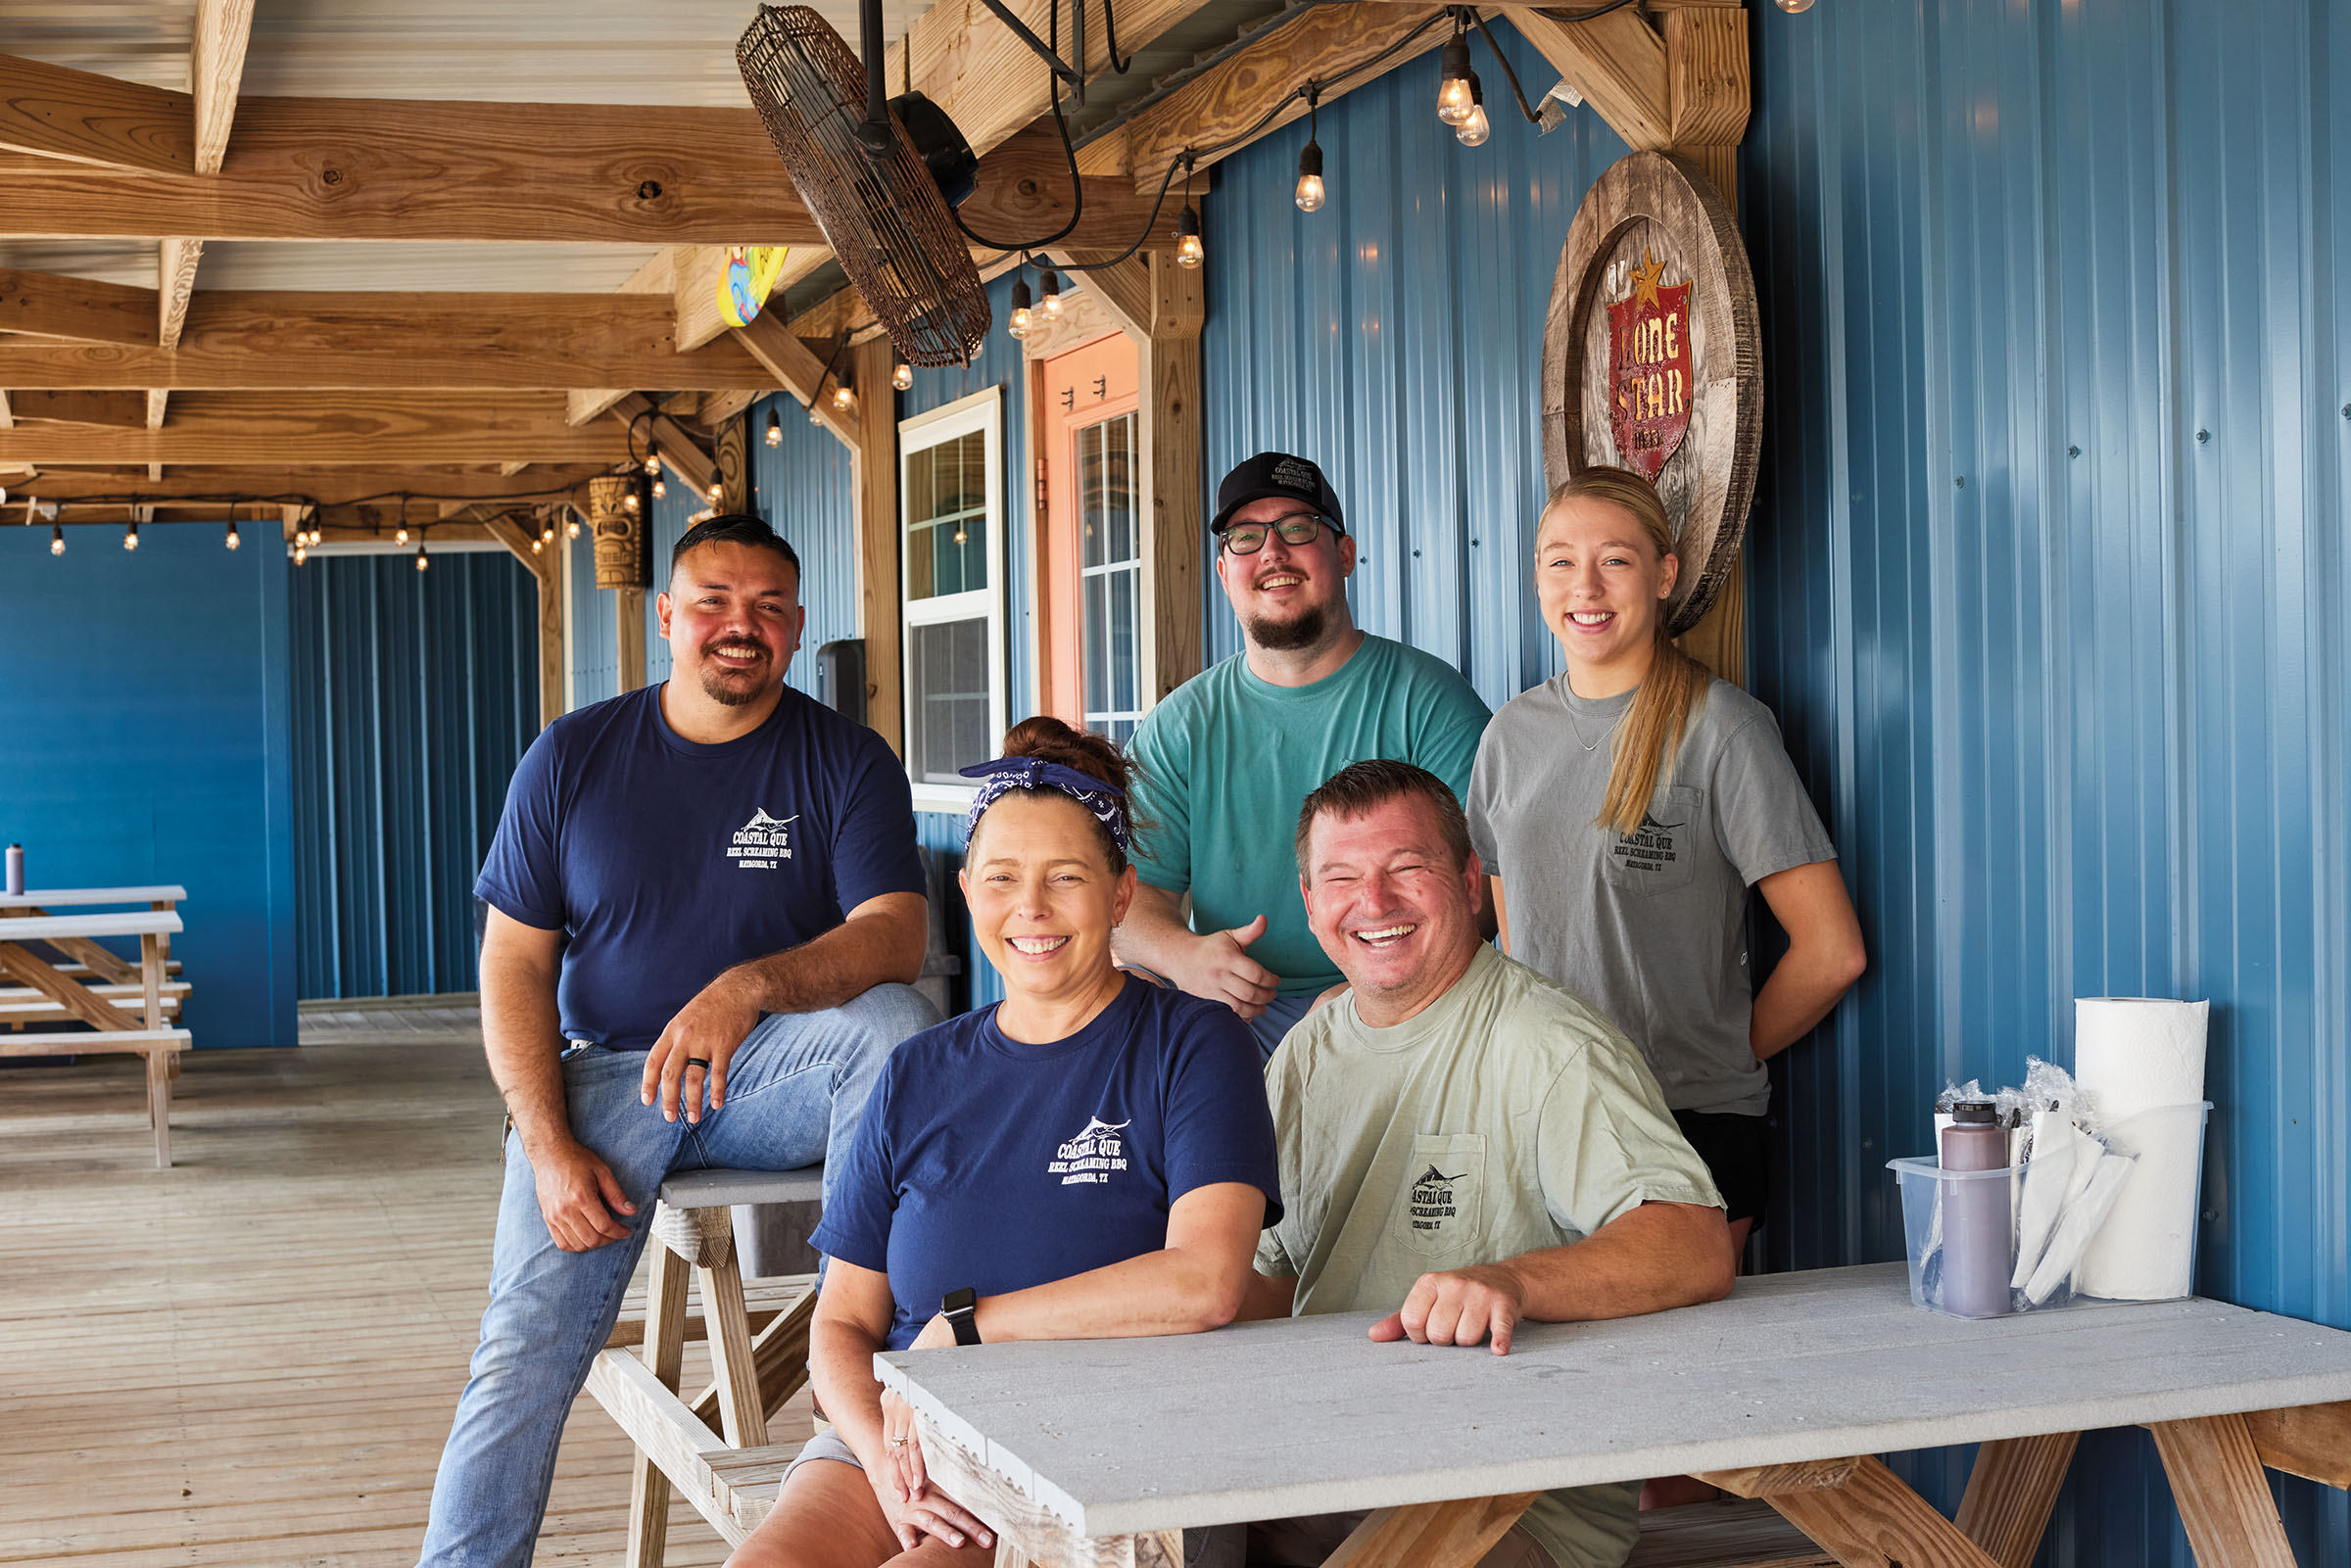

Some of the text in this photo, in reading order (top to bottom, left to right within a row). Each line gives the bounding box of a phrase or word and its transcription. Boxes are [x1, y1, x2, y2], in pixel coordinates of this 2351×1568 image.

[1617, 368, 1684, 423] STAR
[733, 832, 789, 846] COASTAL QUE
[1655, 836, 1673, 850] QUE
[727, 847, 792, 859] REEL SCREAMING BBQ
[1613, 845, 1677, 862] REEL SCREAMING BBQ
[1098, 1140, 1122, 1157] QUE
[1047, 1162, 1069, 1173] REEL
[1110, 1159, 1128, 1170] BBQ
[1099, 1173, 1109, 1183] TX
[1412, 1190, 1453, 1206] ASTAL QUE
[1444, 1207, 1457, 1217] BBQ
[1434, 1221, 1441, 1230] TX
